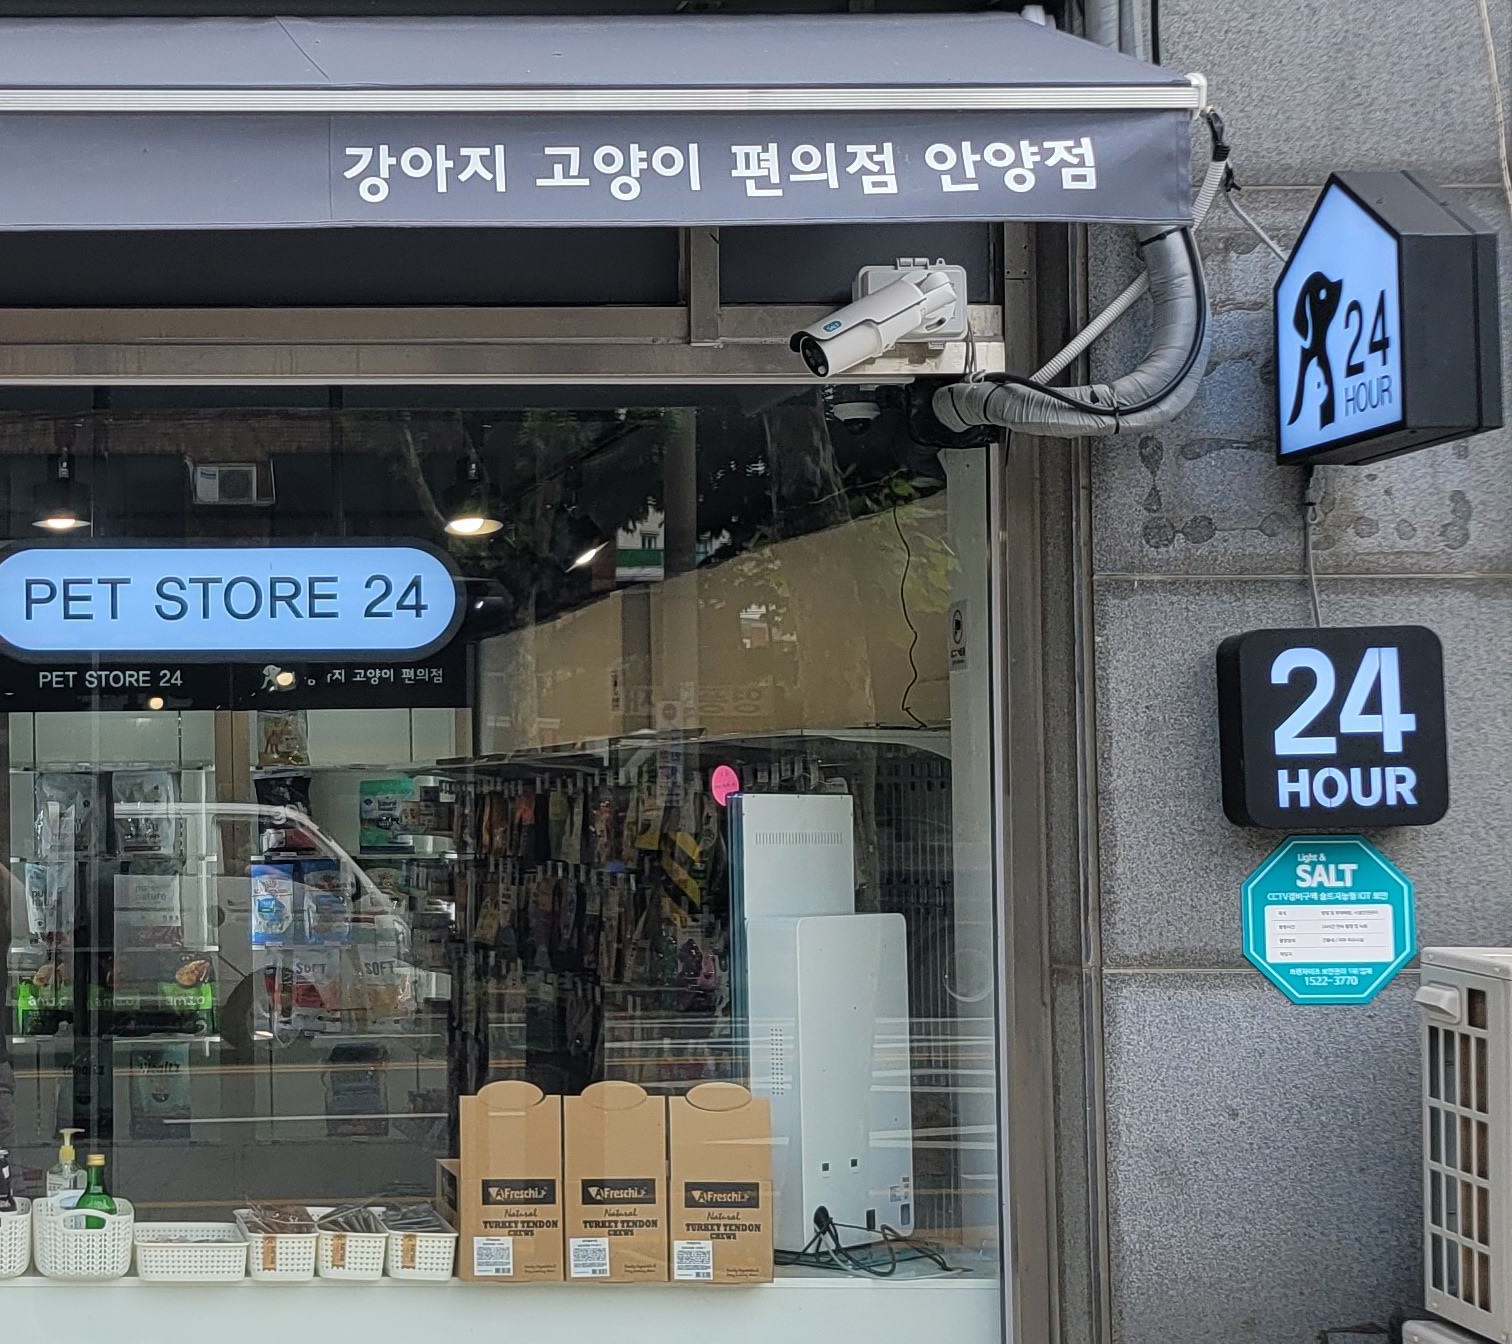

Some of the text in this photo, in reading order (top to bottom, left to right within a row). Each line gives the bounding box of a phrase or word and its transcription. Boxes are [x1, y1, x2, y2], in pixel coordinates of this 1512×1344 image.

[342, 137, 1097, 202] 강아지 고양이 편의점 안양점
[1343, 289, 1390, 379] 24
[1343, 375, 1393, 417] HOUR
[25, 574, 428, 621] PET STORE 24
[39, 670, 183, 688] PET STORE 24
[353, 669, 395, 685] 고양이
[401, 668, 444, 684] 편의점
[1270, 647, 1416, 755] 24
[1278, 766, 1417, 808] HOUR
[1296, 863, 1358, 887] SALT
[1304, 976, 1359, 986] 1522-3770
